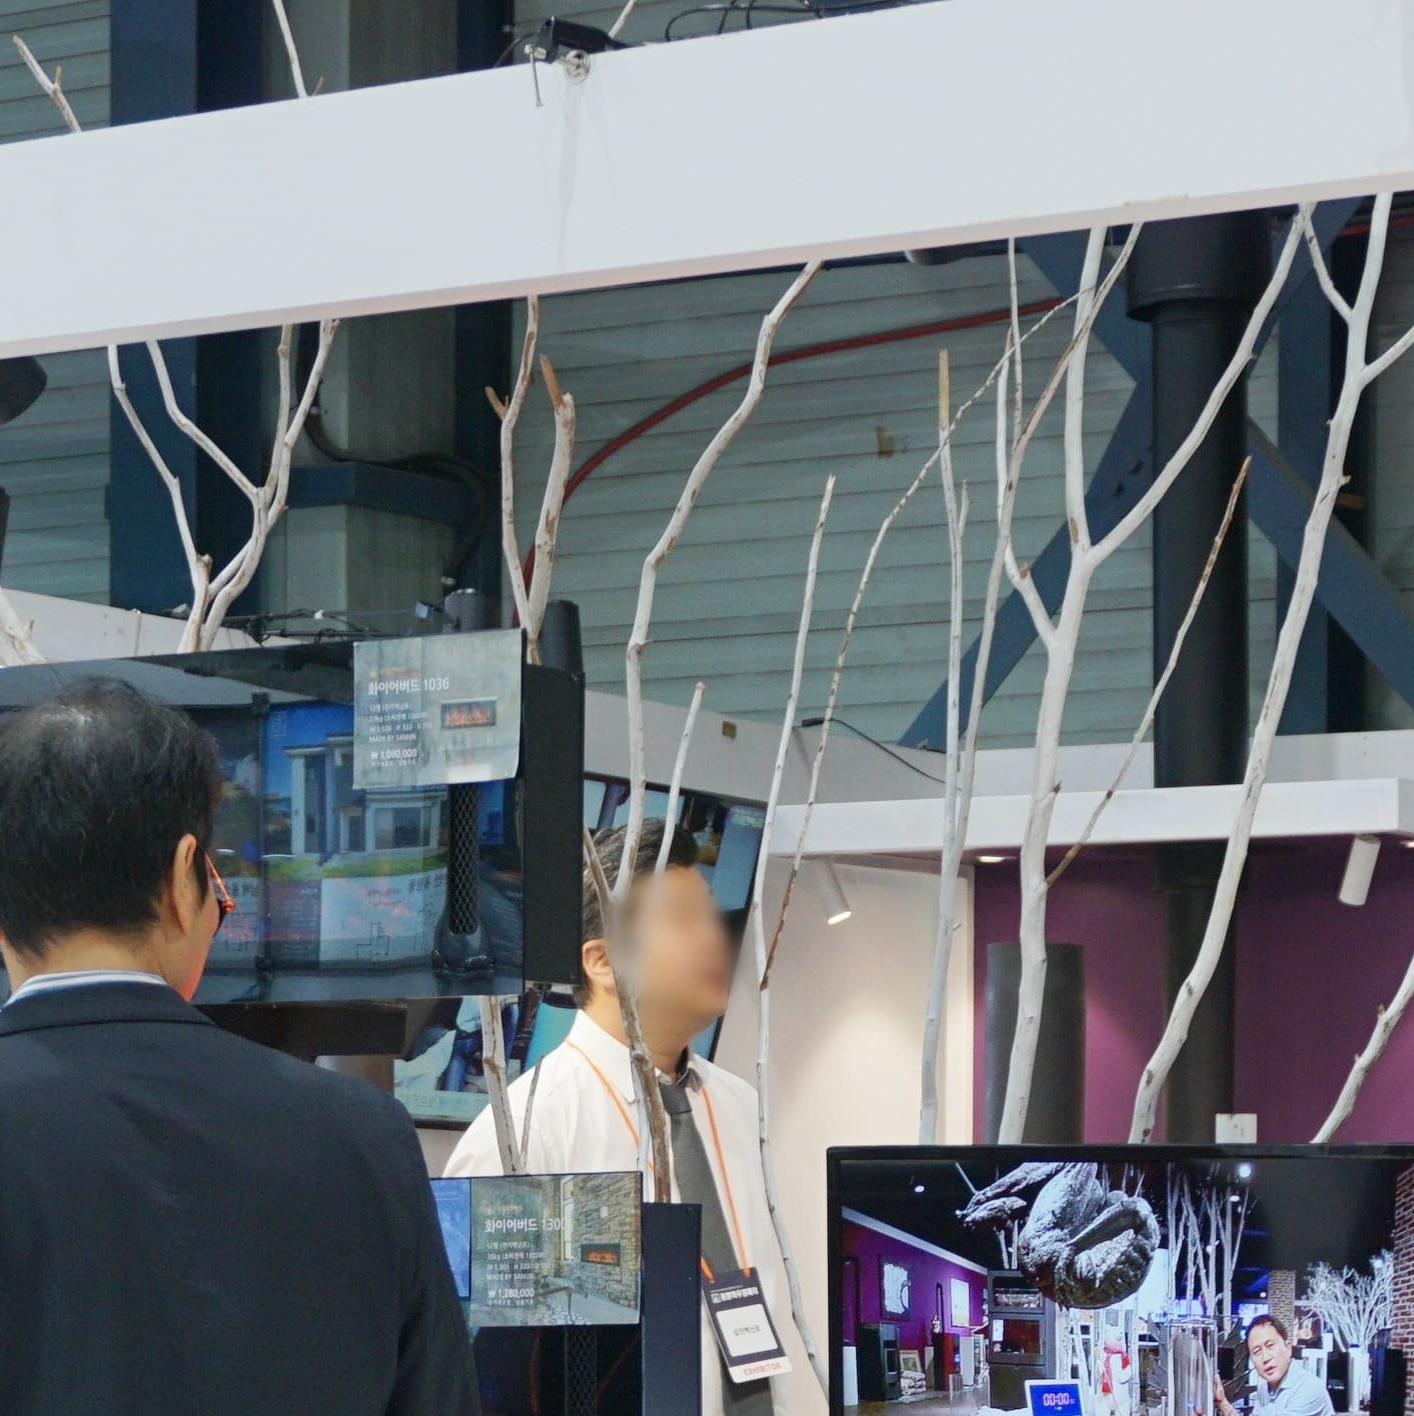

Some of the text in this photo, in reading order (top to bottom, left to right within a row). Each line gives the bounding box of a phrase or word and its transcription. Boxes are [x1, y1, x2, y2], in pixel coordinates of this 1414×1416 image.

[424, 677, 450, 691] 1036
[484, 1218, 539, 1233] 화이어버드
[498, 1287, 535, 1299] 1,280,000
